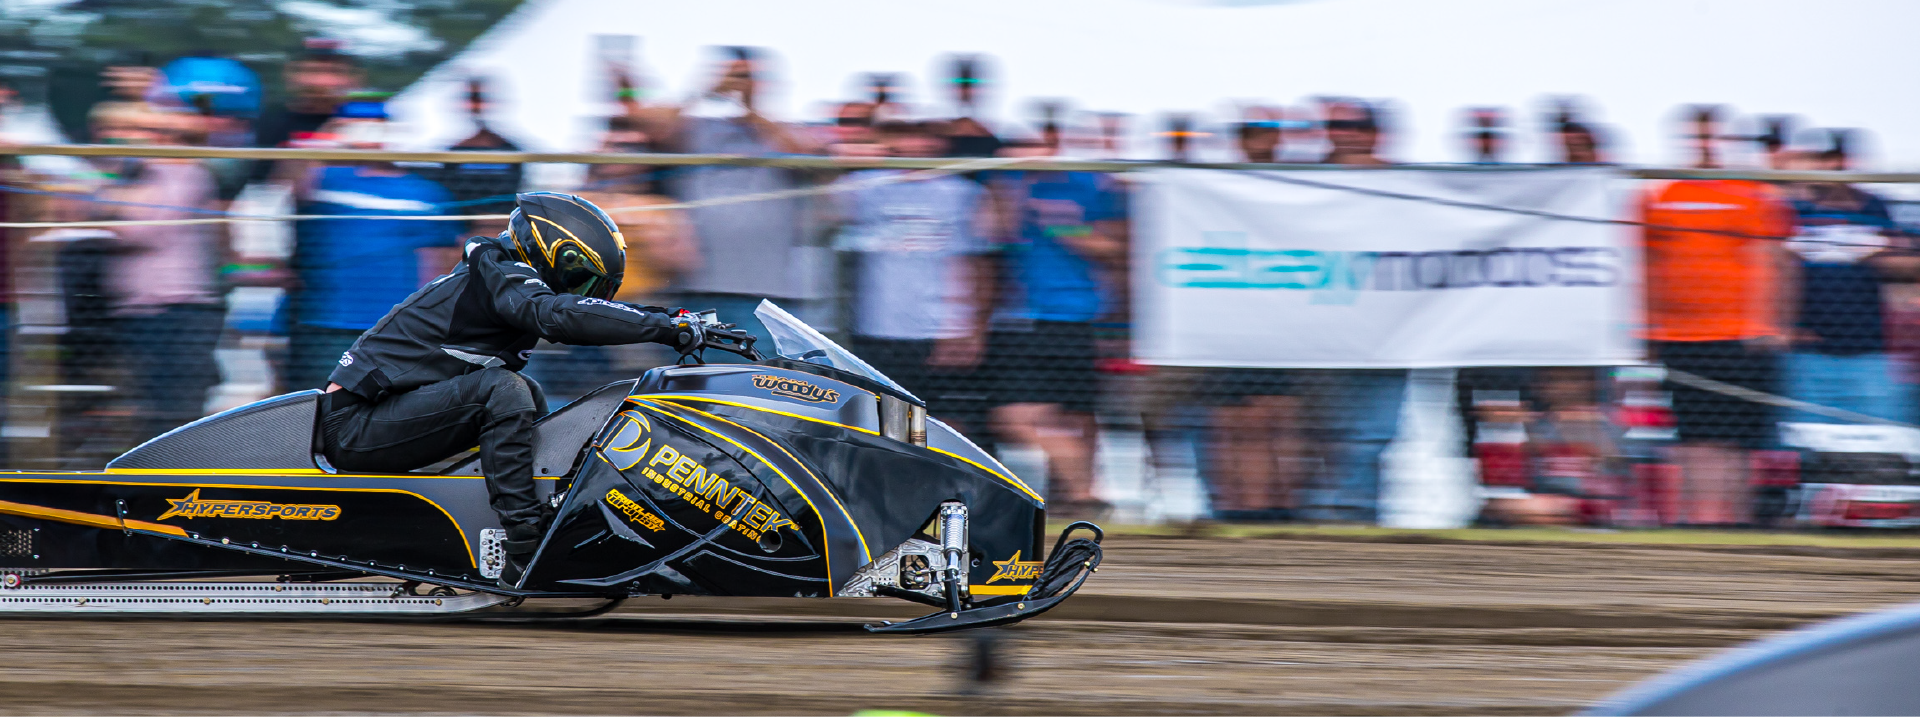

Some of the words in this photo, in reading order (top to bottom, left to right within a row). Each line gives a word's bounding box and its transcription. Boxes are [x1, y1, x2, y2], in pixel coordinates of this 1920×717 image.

[179, 500, 341, 520] HYPERSPORTS
[641, 466, 711, 514] INDUSTRIAL
[648, 444, 792, 532] PENNTEK
